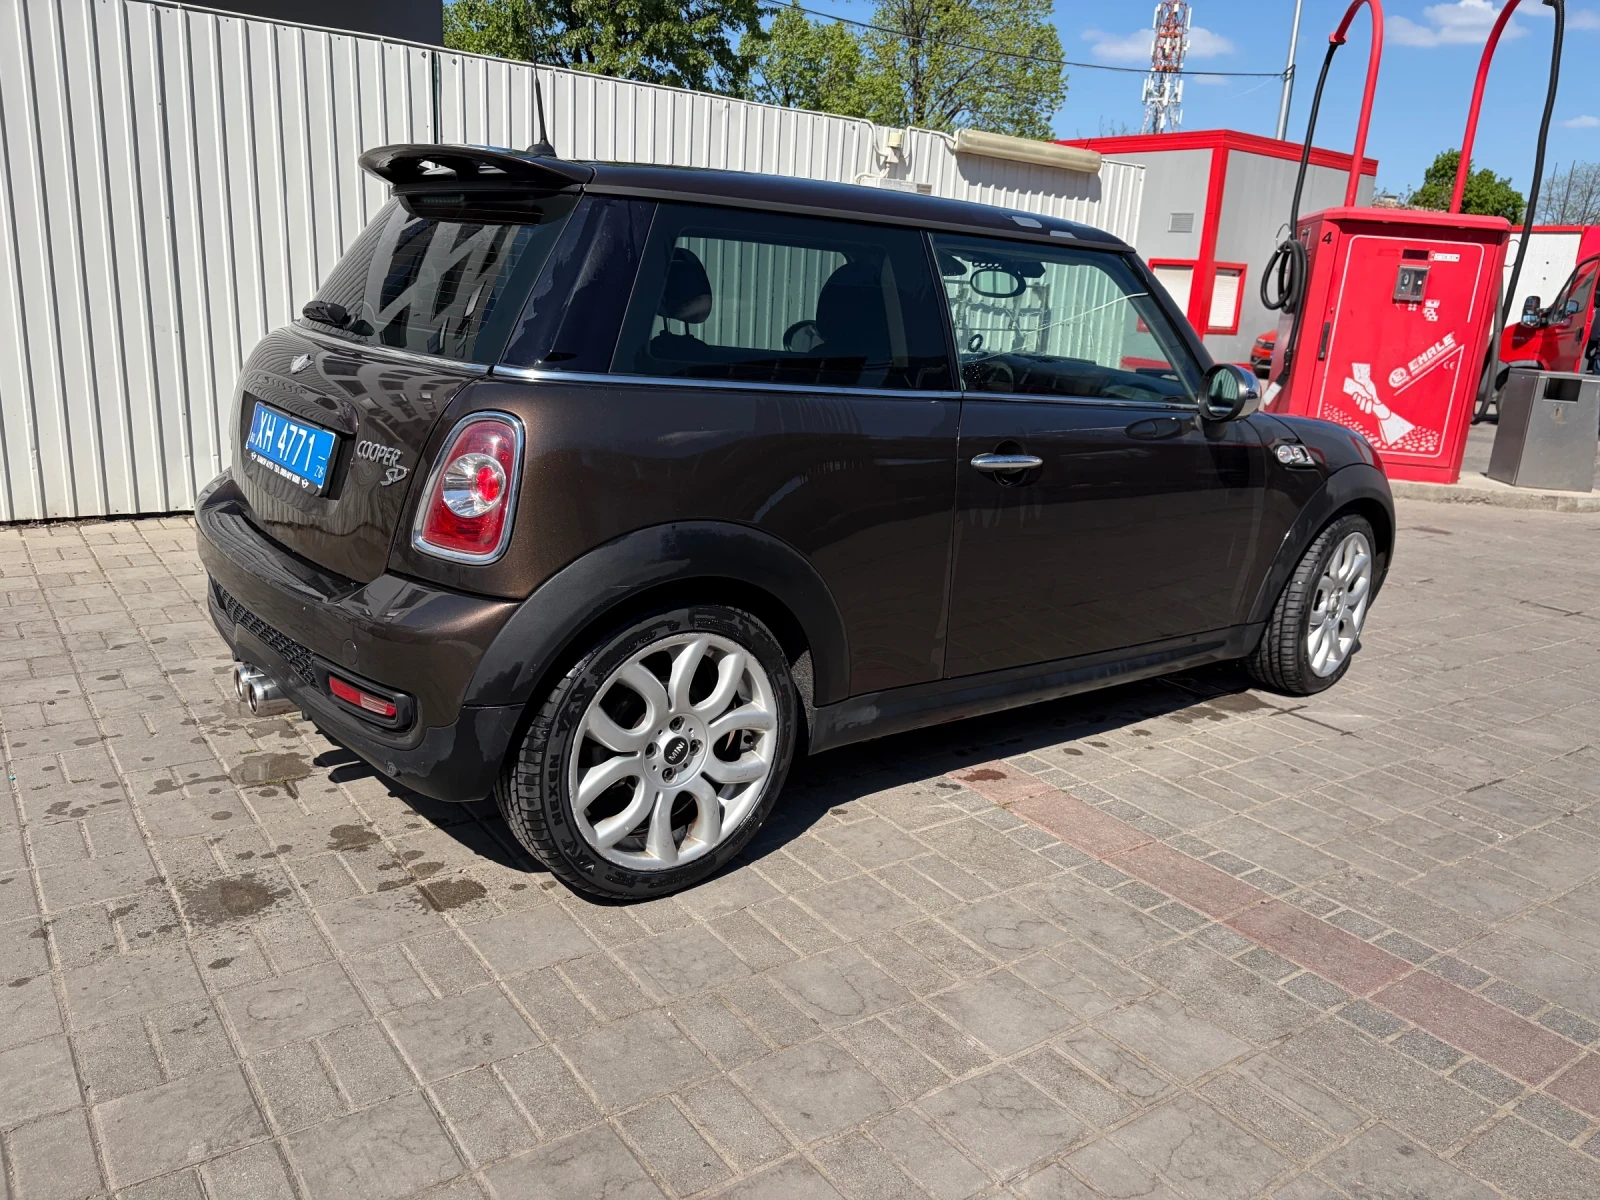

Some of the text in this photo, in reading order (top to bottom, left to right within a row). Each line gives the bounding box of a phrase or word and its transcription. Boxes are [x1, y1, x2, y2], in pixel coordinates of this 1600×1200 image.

[1321, 231, 1333, 244] 4
[255, 411, 277, 453] XH
[277, 422, 316, 472] 4771
[356, 440, 401, 467] COOPER
[379, 464, 408, 486] SD
[668, 741, 686, 761] MINI
[548, 754, 563, 827] NEXEN
